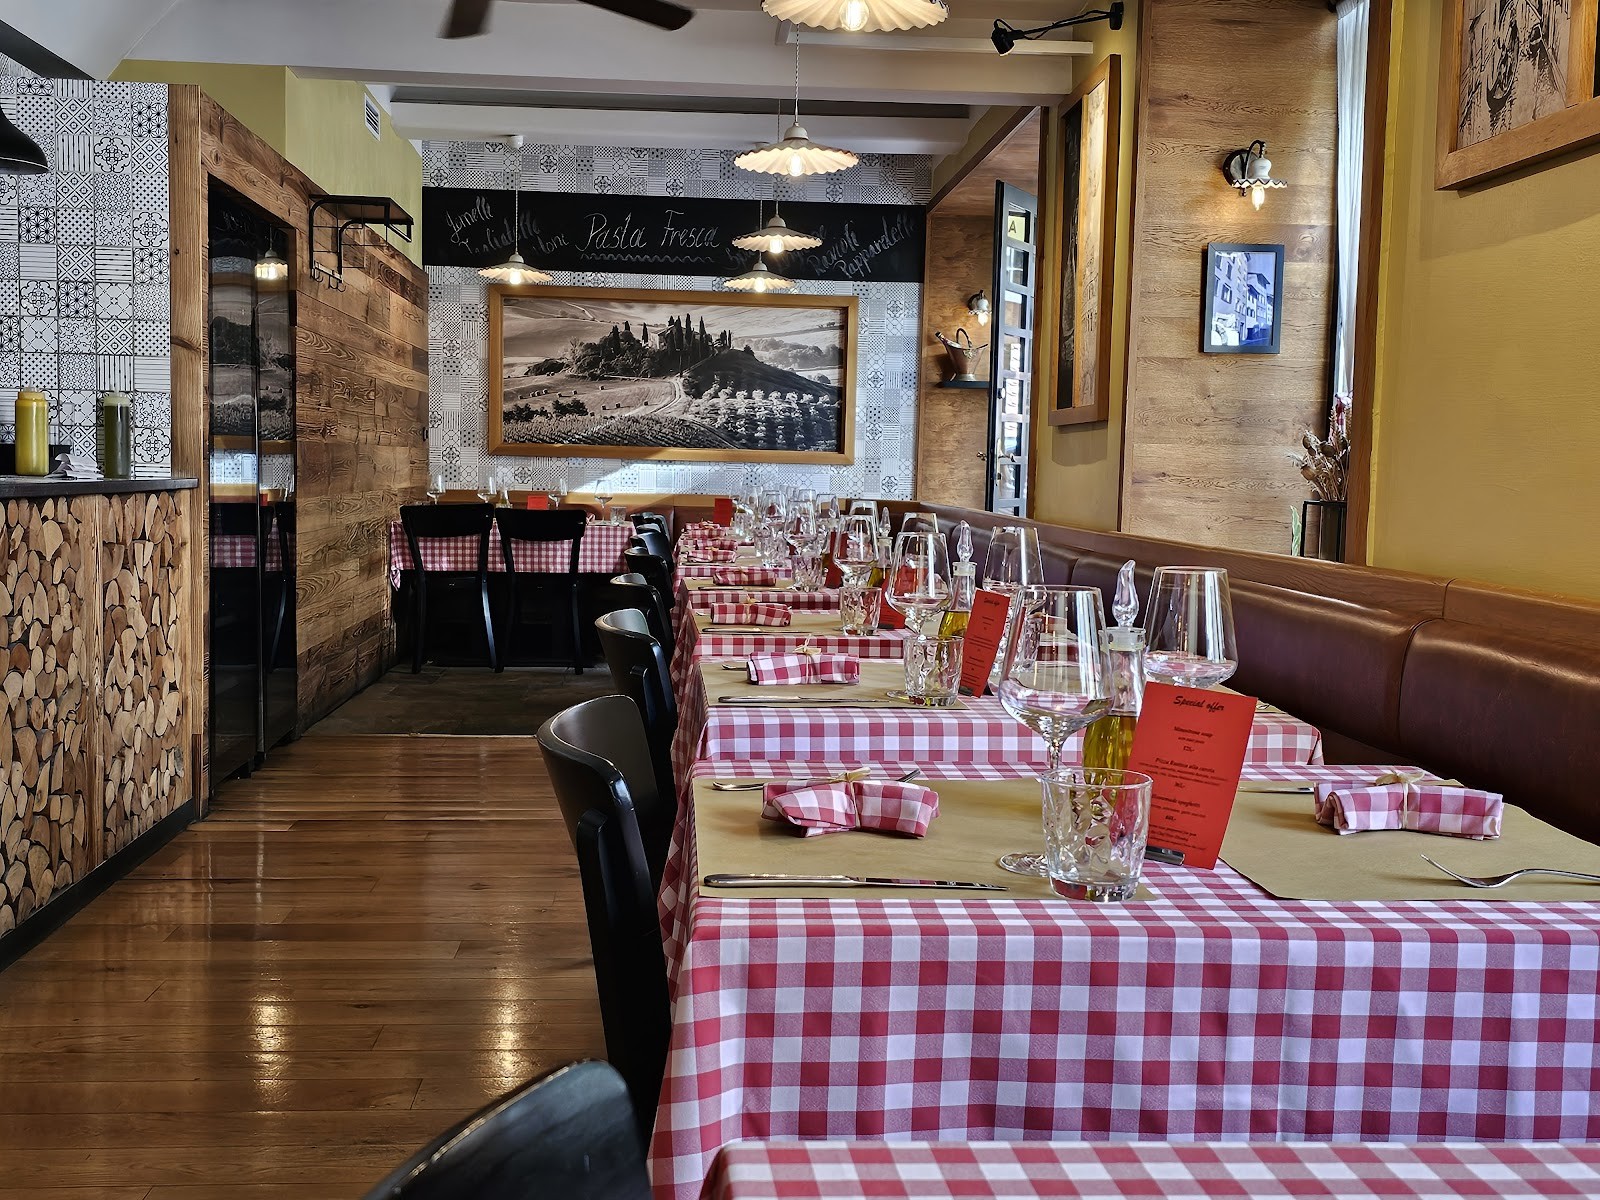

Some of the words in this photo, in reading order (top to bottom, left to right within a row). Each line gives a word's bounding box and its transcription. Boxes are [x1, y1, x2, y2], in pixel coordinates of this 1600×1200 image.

[575, 212, 647, 251] Pasta
[660, 210, 720, 247] Fresca
[1173, 695, 1204, 708] Special
[1206, 701, 1225, 712] offer
